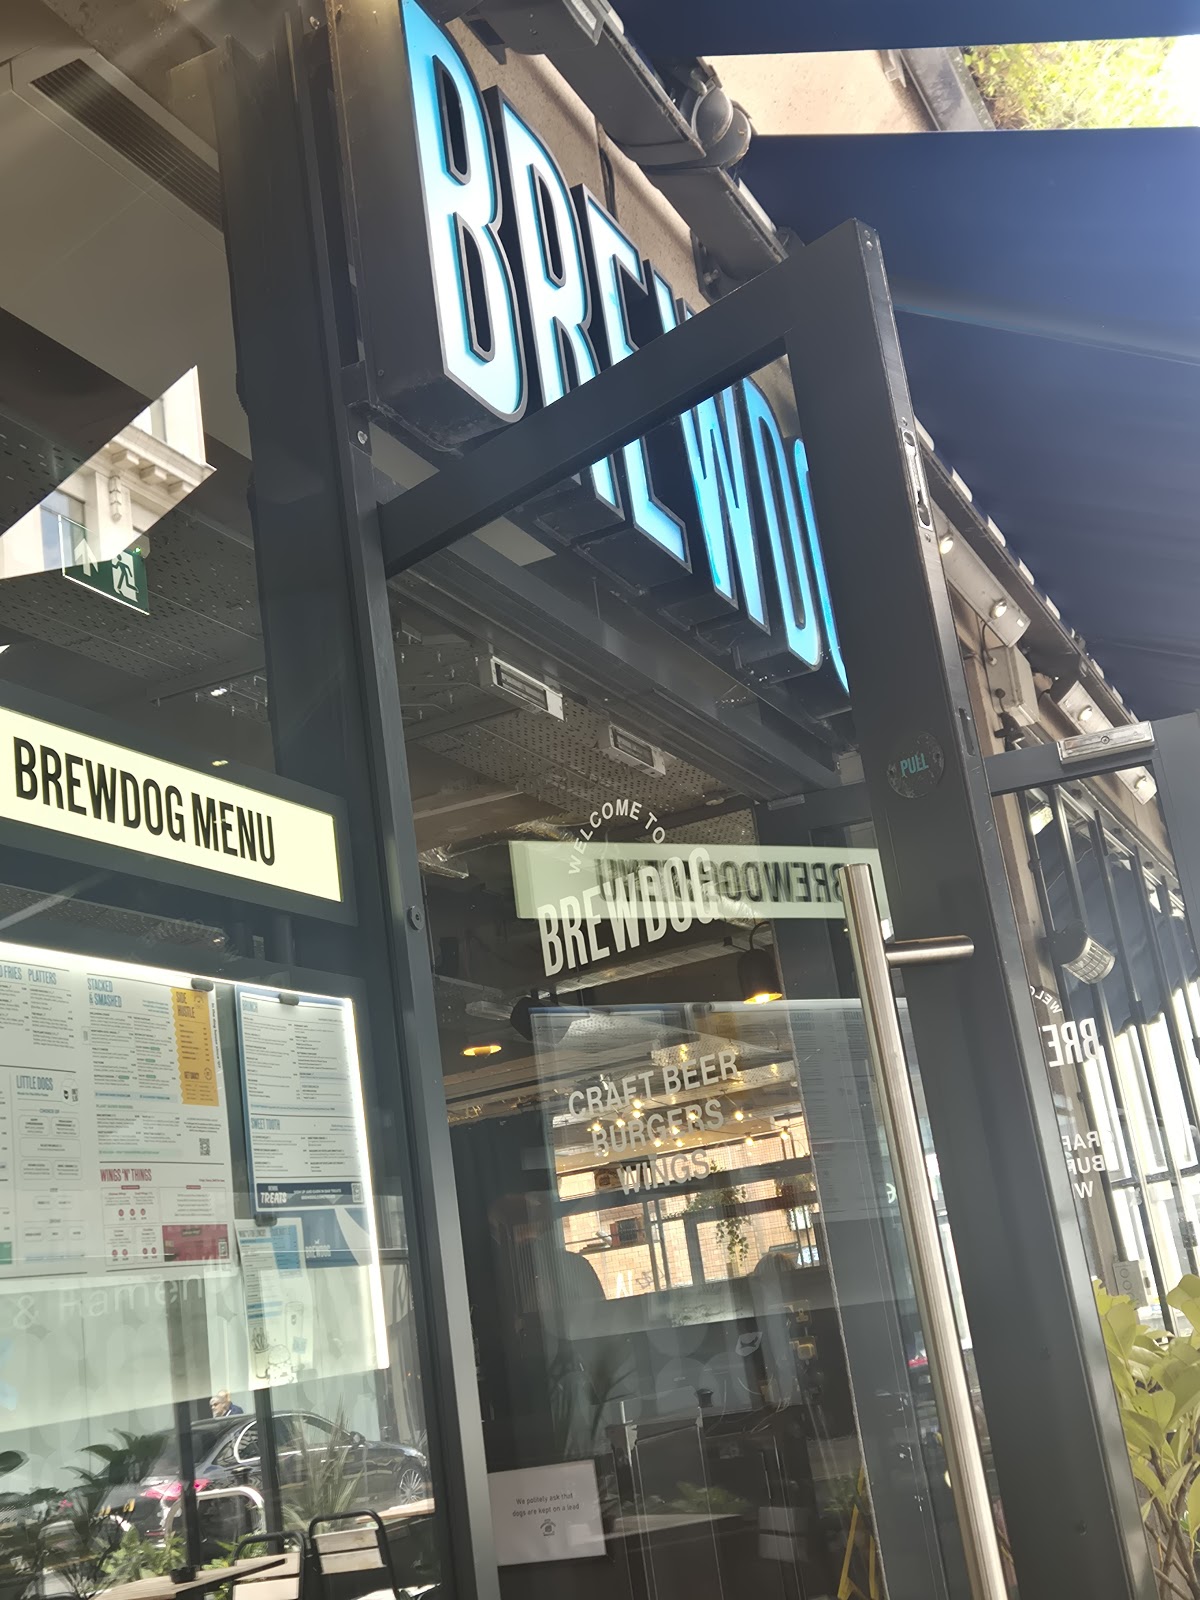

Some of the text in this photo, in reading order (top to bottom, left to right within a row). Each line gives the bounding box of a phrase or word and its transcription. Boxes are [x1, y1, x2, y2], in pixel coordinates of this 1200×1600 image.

[401, 0, 849, 694] BREWD
[900, 753, 929, 777] PULL
[13, 736, 275, 866] BREWDOG MENU
[568, 799, 667, 875] WELCOME TO
[537, 847, 720, 977] BREWDOG
[28, 968, 57, 986] PLATTERS
[87, 978, 113, 992] STACKED
[94, 993, 122, 1008] SMASHED
[16, 1075, 54, 1091] LITTLE DOGS
[568, 1050, 738, 1119] CRAFT BEER
[592, 1099, 725, 1157] BURGERS
[100, 1169, 121, 1182] WINGS
[131, 1169, 152, 1181] THINGS
[616, 1149, 712, 1195] WINGS
[260, 1192, 287, 1204] TREATS
[527, 1495, 548, 1505] politely
[549, 1494, 560, 1502] ask
